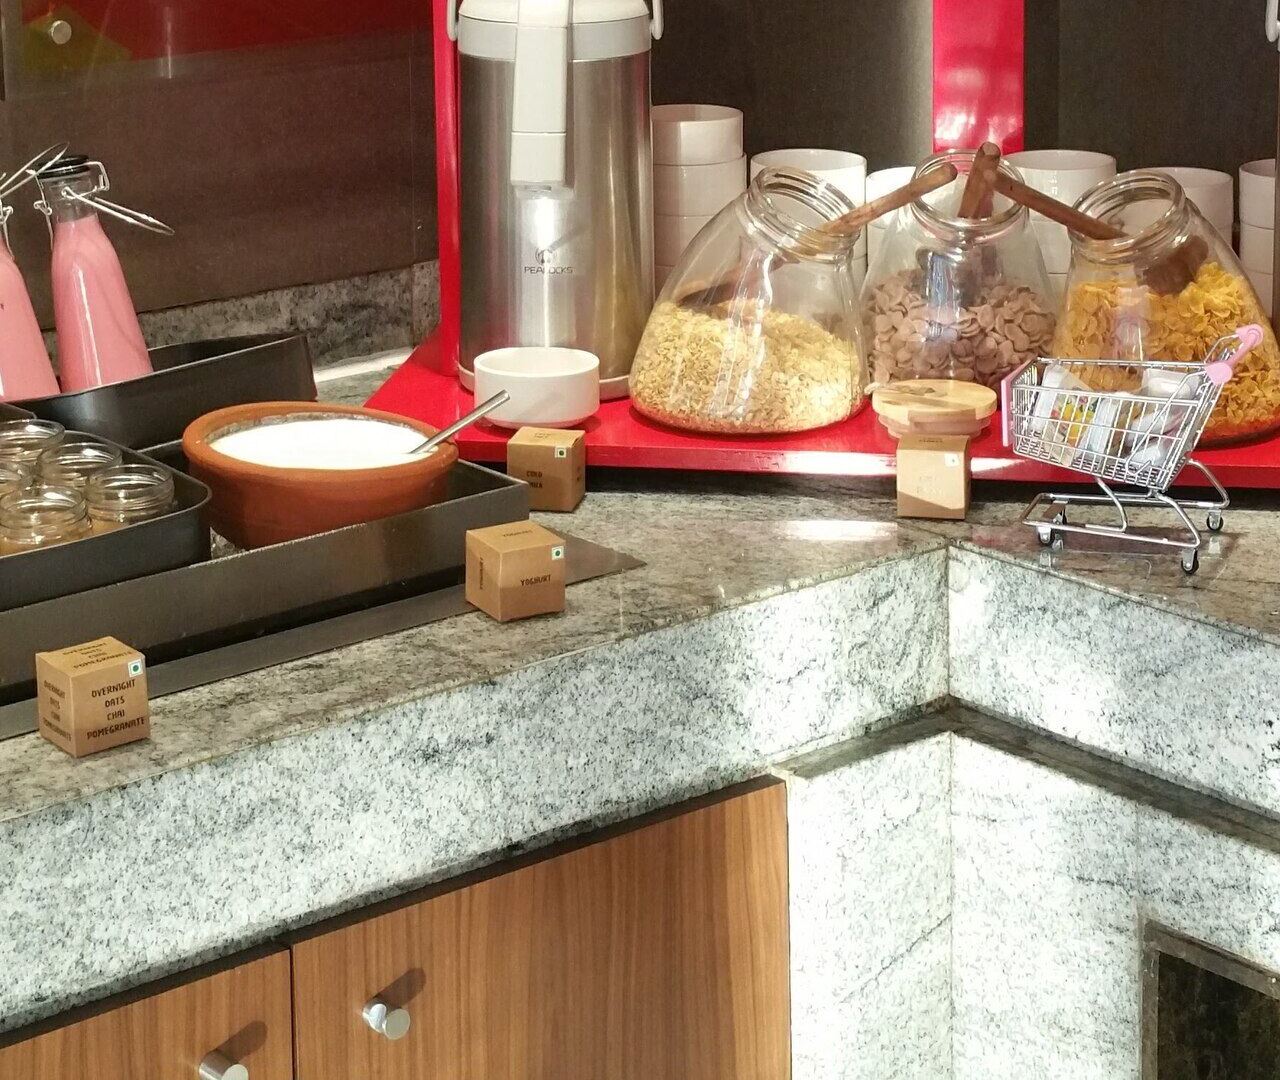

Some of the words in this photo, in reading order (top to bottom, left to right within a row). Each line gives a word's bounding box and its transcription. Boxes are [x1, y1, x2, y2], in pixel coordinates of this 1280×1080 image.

[91, 679, 136, 698] OVERNIGHT
[105, 696, 125, 708] OATS
[107, 710, 125, 721] CHAI
[87, 716, 145, 739] POMEGRANATE
